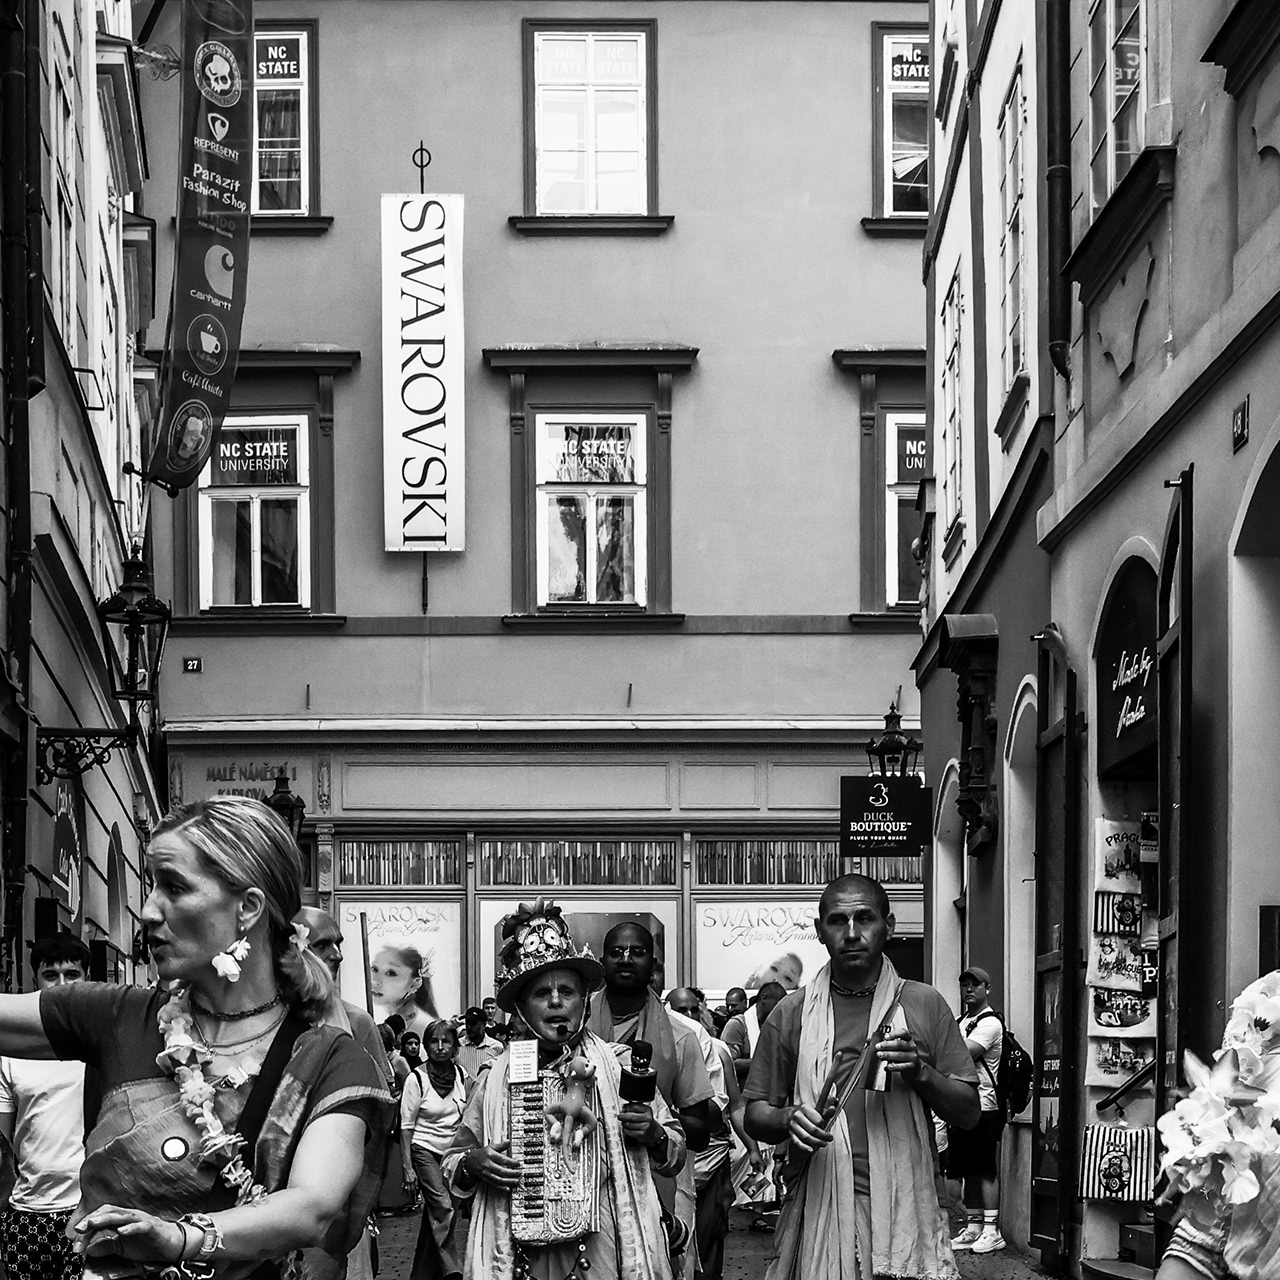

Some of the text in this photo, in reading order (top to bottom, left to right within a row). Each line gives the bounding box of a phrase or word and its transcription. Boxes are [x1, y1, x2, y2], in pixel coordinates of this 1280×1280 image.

[268, 46, 287, 59] NC
[902, 49, 921, 62] NC
[258, 61, 298, 75] STATE
[893, 64, 930, 77] STATE
[194, 137, 240, 161] REPRESENT
[193, 163, 241, 192] Parazit
[183, 177, 247, 213] Fashion Shop
[189, 289, 232, 311] carhartt
[400, 200, 448, 546] SWAROVSKI
[220, 442, 288, 457] NC STATE
[582, 440, 625, 454] STATE
[906, 441, 926, 455] NC
[220, 458, 289, 472] UNIVERSITY
[187, 661, 198, 670] 27
[206, 762, 236, 782] MALÉ
[863, 812, 894, 821] DUCK
[850, 822, 908, 833] BOUTIQUE
[1111, 962, 1142, 974] PRAGUE
